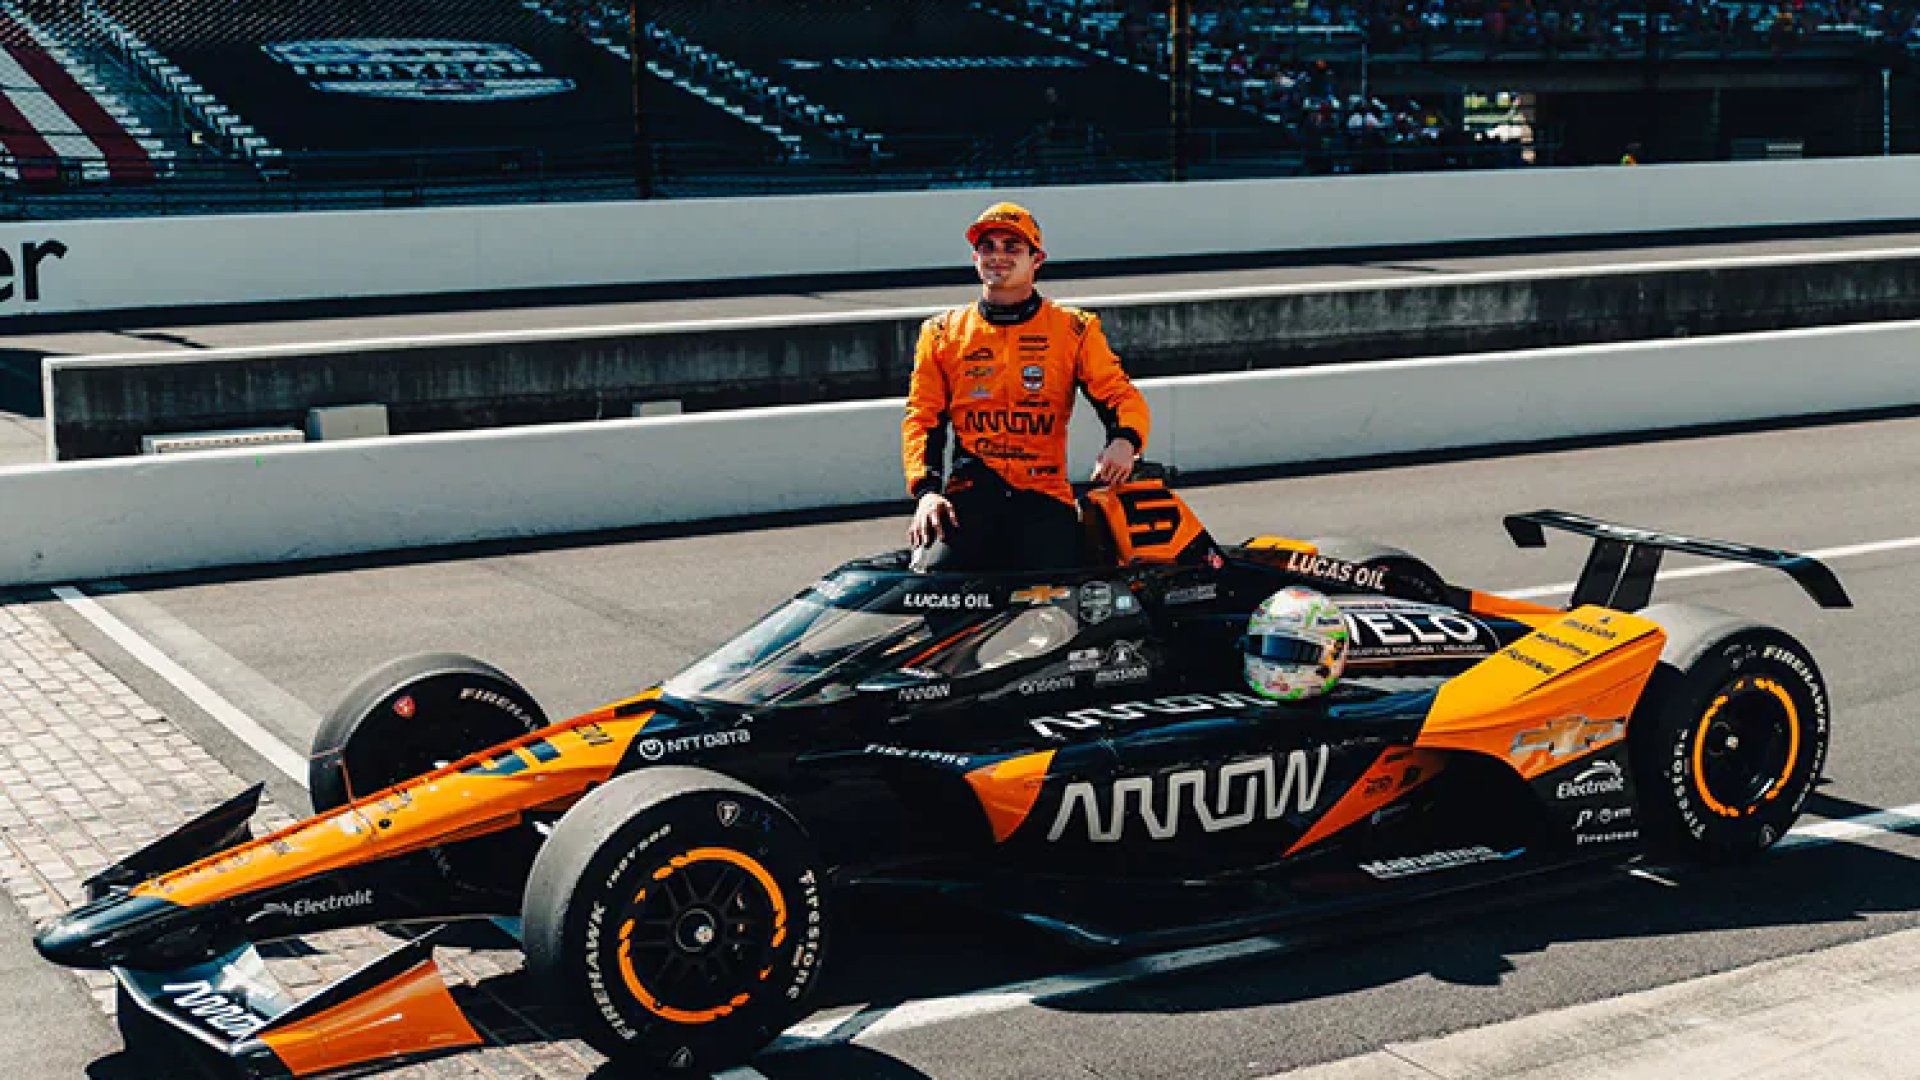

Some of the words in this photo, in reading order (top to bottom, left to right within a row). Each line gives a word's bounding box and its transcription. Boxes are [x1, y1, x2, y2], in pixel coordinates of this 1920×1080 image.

[0, 239, 68, 302] r
[964, 410, 1055, 435] ARROW
[1287, 551, 1352, 582] LUCAS
[1353, 565, 1387, 591] OIL
[903, 593, 960, 609] LUCAS
[963, 593, 994, 609] OIL
[1763, 644, 1826, 733] FIREHAWK
[667, 735, 700, 752] NTT
[1046, 744, 1330, 842] ARROW
[293, 888, 373, 917] Electrolit
[786, 869, 820, 998] Firestone
[585, 901, 638, 1040] FIREHAWK
